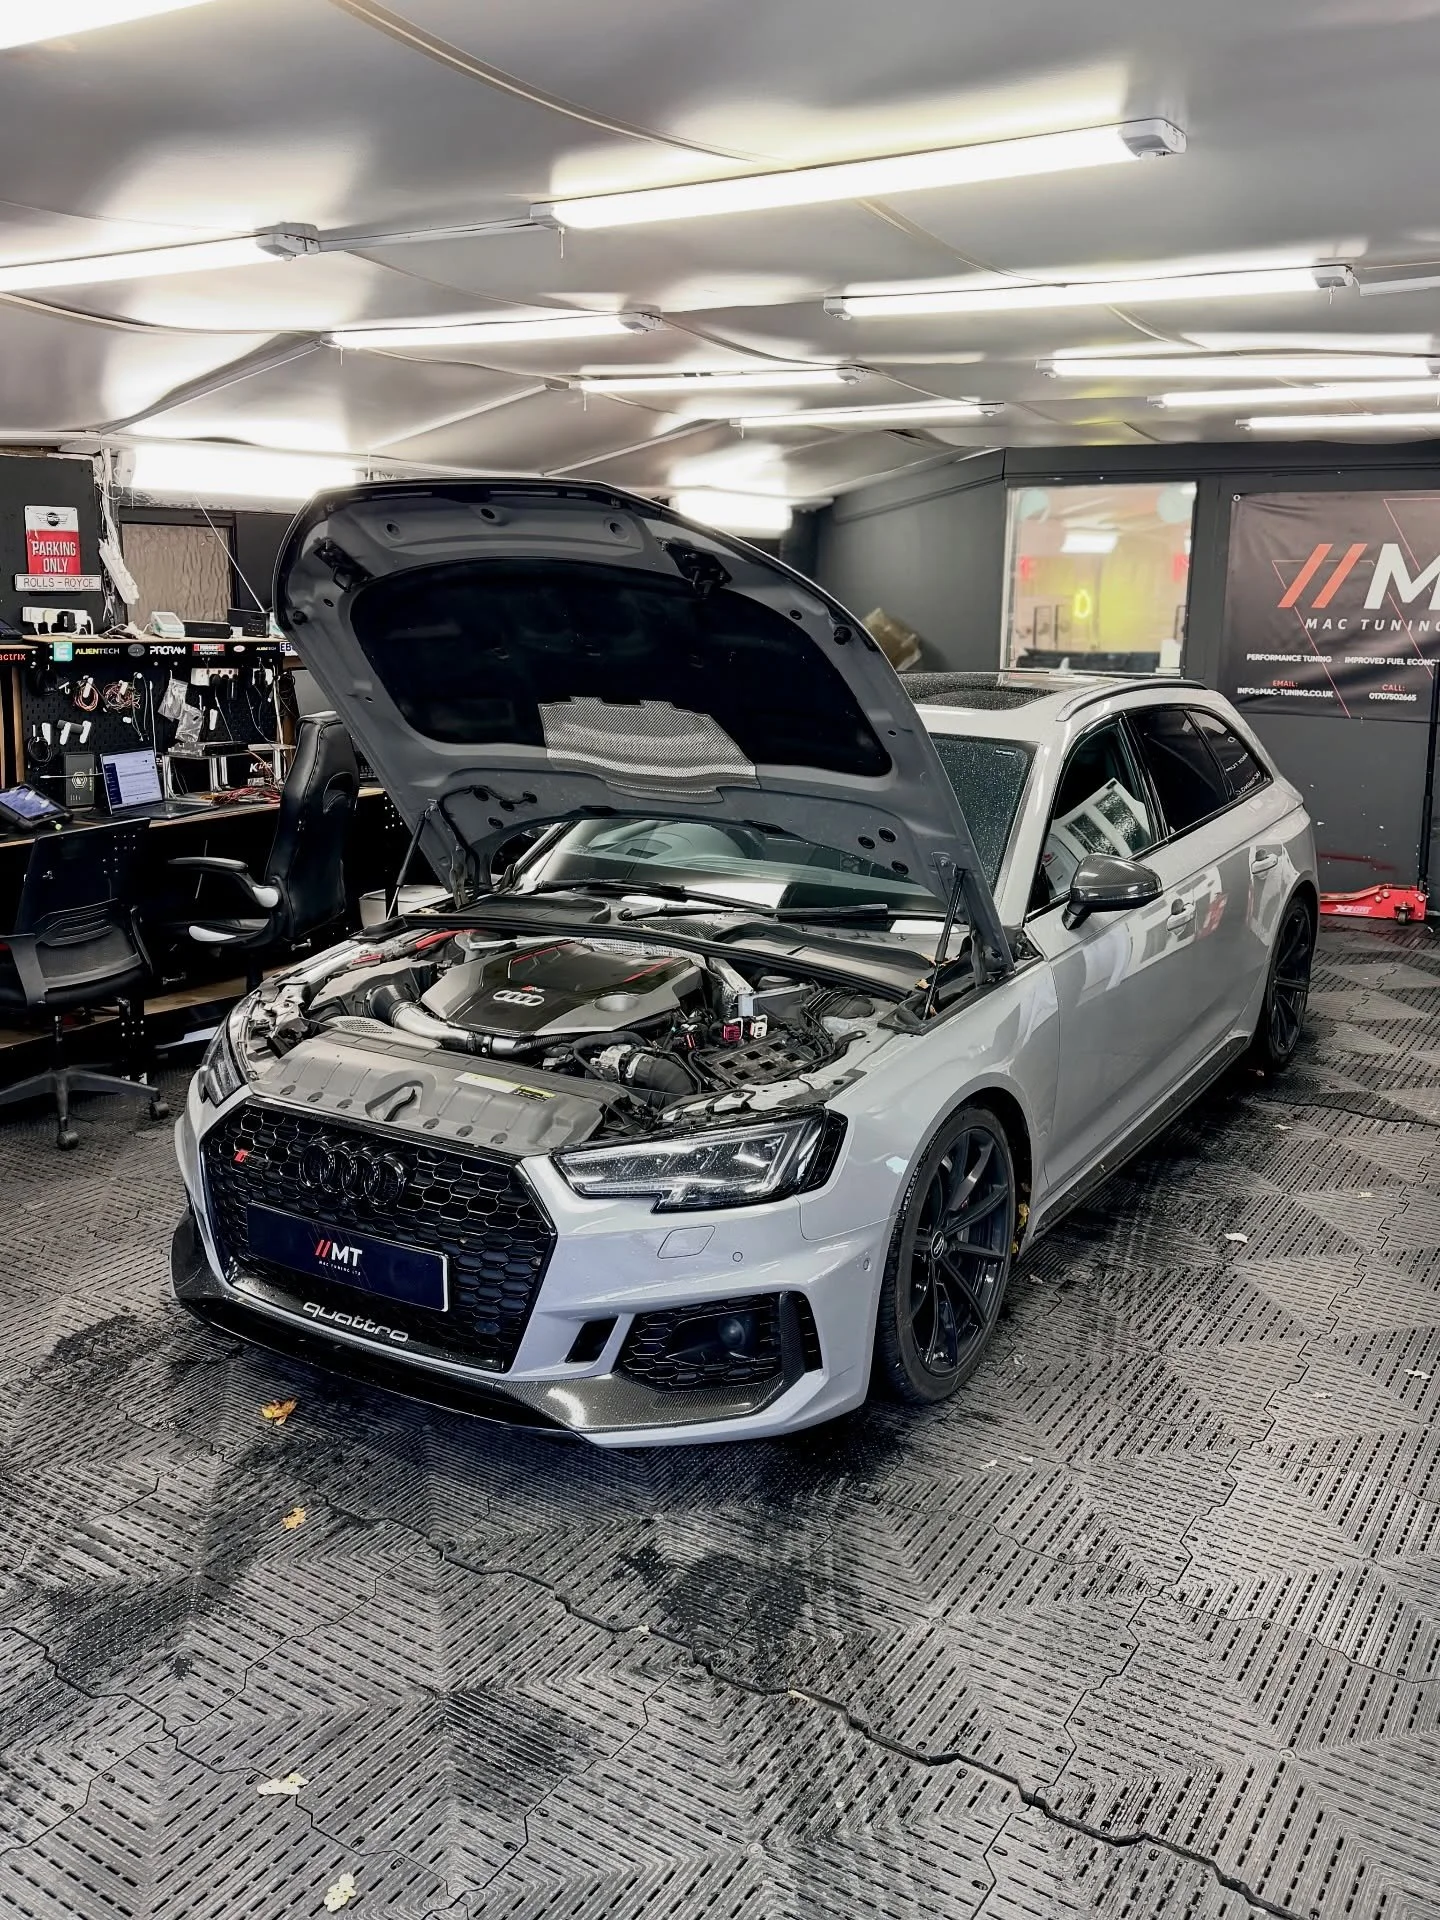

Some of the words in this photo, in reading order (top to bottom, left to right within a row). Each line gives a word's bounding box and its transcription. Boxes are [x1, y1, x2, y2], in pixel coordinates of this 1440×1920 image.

[32, 541, 76, 556] PARKING
[43, 558, 68, 573] ONLY
[1306, 618, 1348, 630] MAC
[1247, 653, 1302, 662] PERFORMANCE
[1303, 655, 1332, 663] TUNING
[1345, 656, 1385, 665] IMPROVED
[1386, 658, 1405, 666] FUEL
[303, 1301, 408, 1343] quattro
